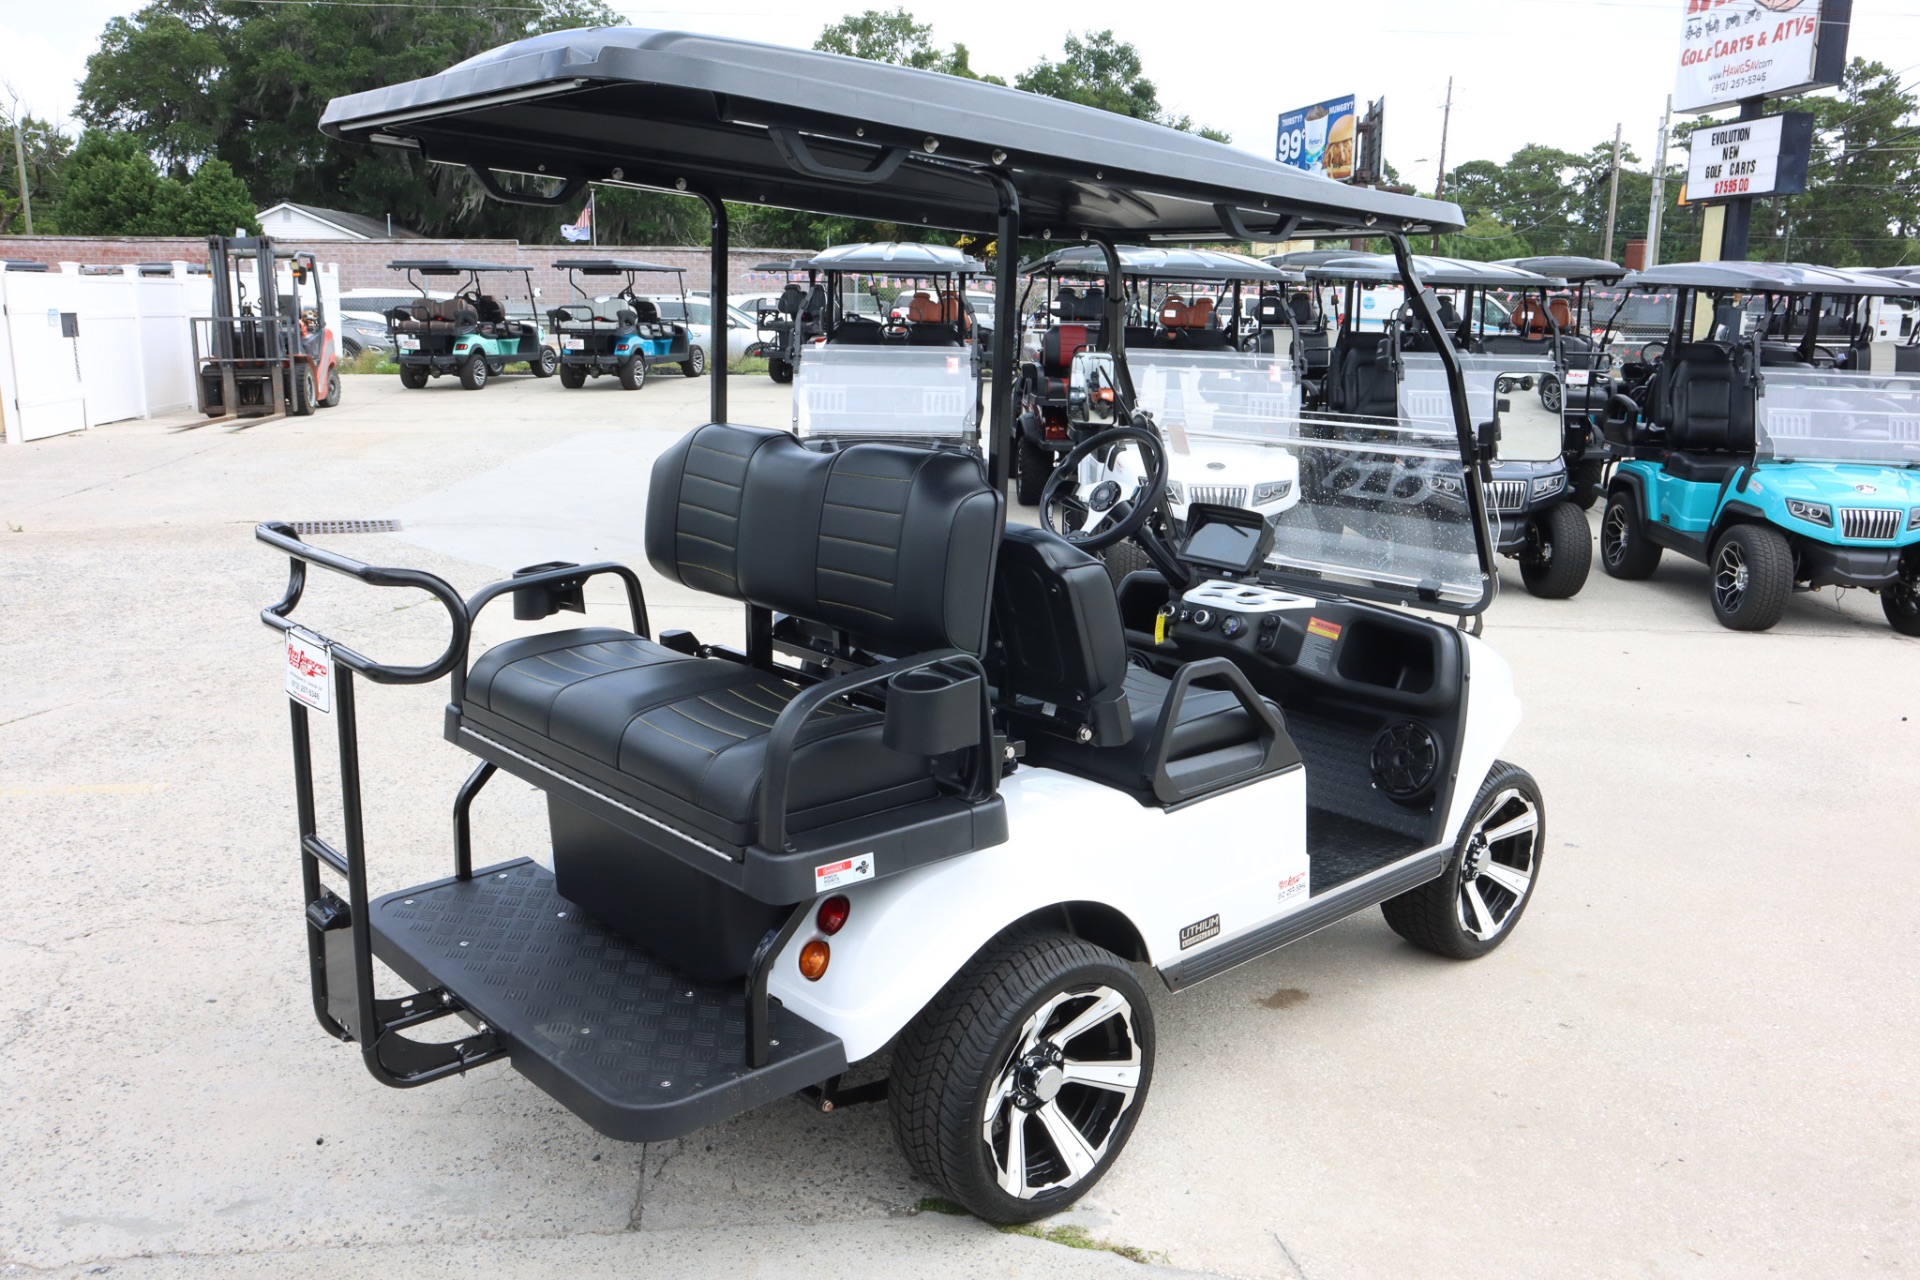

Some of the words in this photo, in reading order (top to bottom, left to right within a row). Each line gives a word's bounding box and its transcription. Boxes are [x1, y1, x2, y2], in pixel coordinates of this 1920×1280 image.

[1681, 47, 1713, 67] GOLF
[1714, 34, 1754, 59] CARTS
[1757, 31, 1767, 47] &
[1329, 101, 1354, 115] HUNGRY?
[1282, 114, 1303, 127] THIRSTY?
[1711, 127, 1751, 146] EVOLUTION
[1722, 145, 1740, 161] NEW
[1705, 164, 1723, 179] GOLF
[1729, 159, 1756, 176] CARTS
[1181, 915, 1219, 940] LITHIUM
